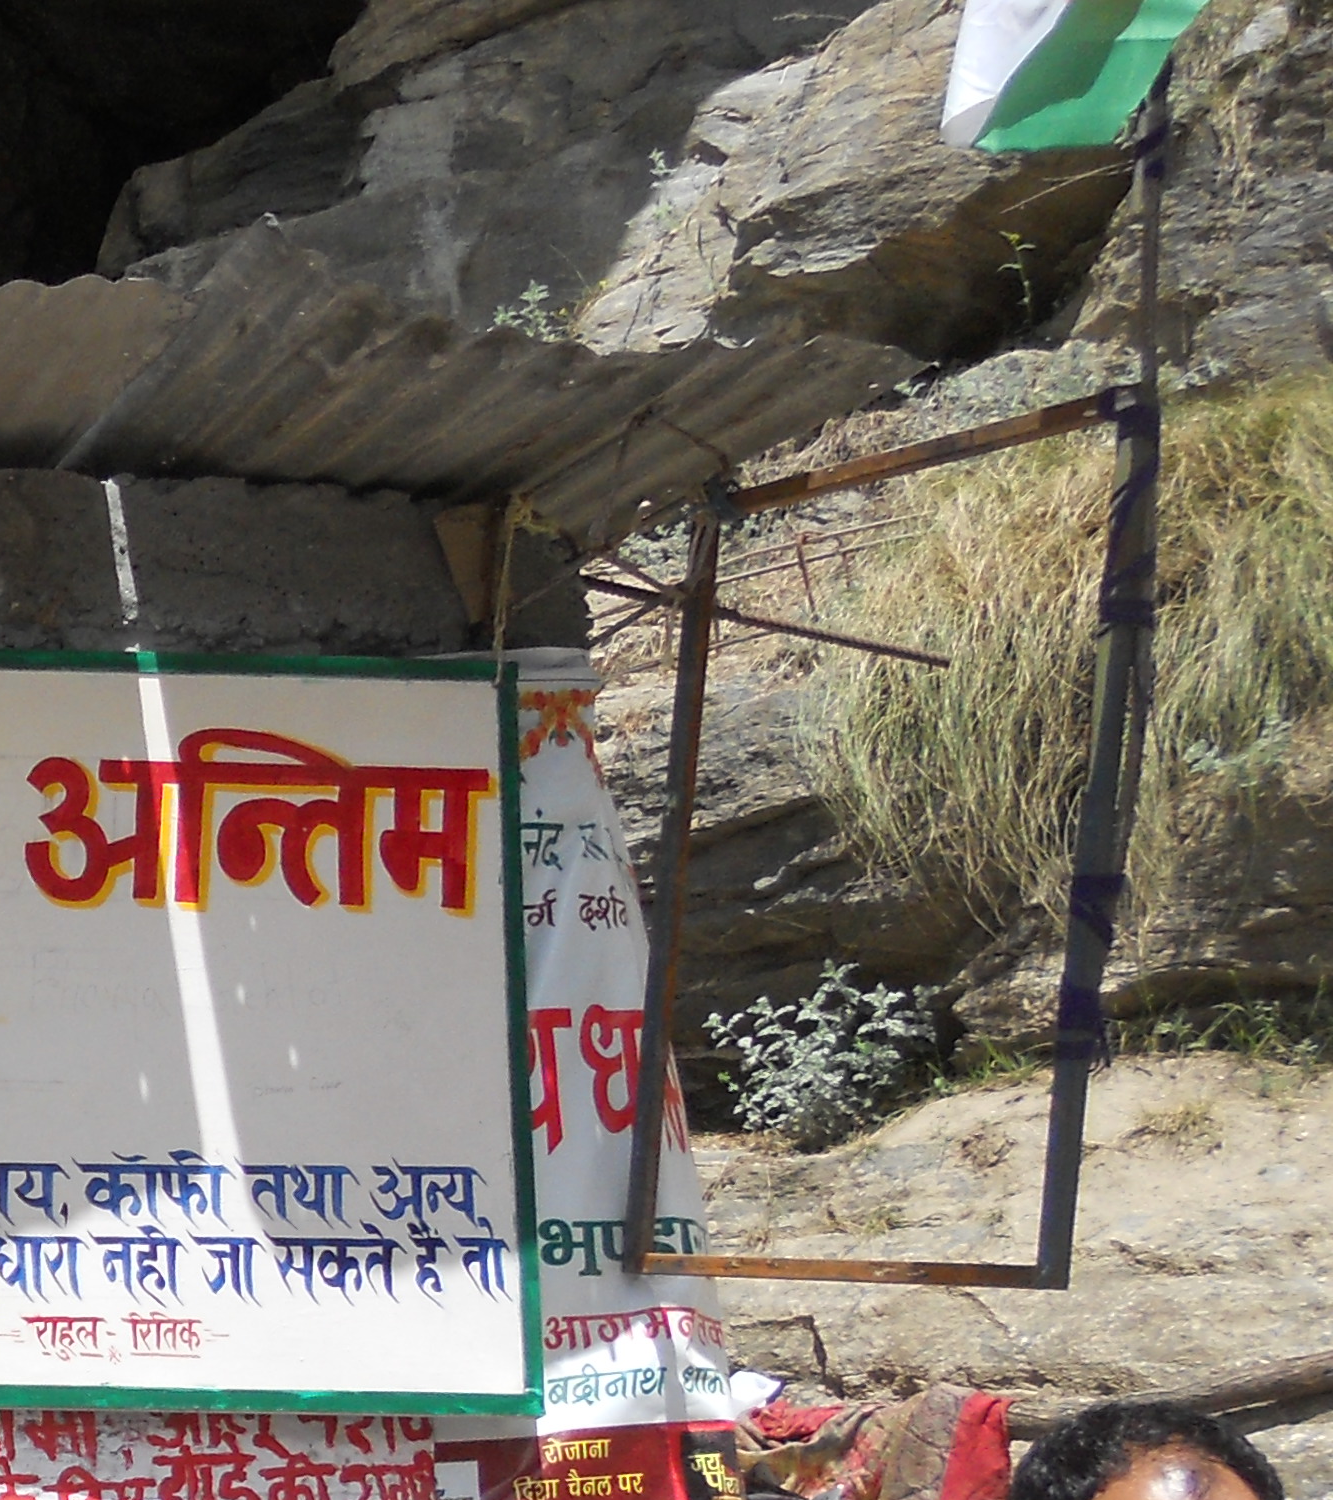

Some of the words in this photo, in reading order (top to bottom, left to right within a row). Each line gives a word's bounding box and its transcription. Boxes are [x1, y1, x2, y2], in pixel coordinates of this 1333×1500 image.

[25, 727, 497, 918] अन्तिम
[236, 1152, 369, 1226] तथा
[369, 1155, 489, 1226] अन्य
[190, 1236, 271, 1306] जा
[269, 1228, 409, 1307] सकते
[453, 1216, 520, 1304] तो
[546, 1363, 667, 1406] बद्रीनाथ
[541, 1437, 612, 1464] रोजाना
[564, 1469, 612, 1497] चैनल
[616, 1472, 644, 1494] पर
